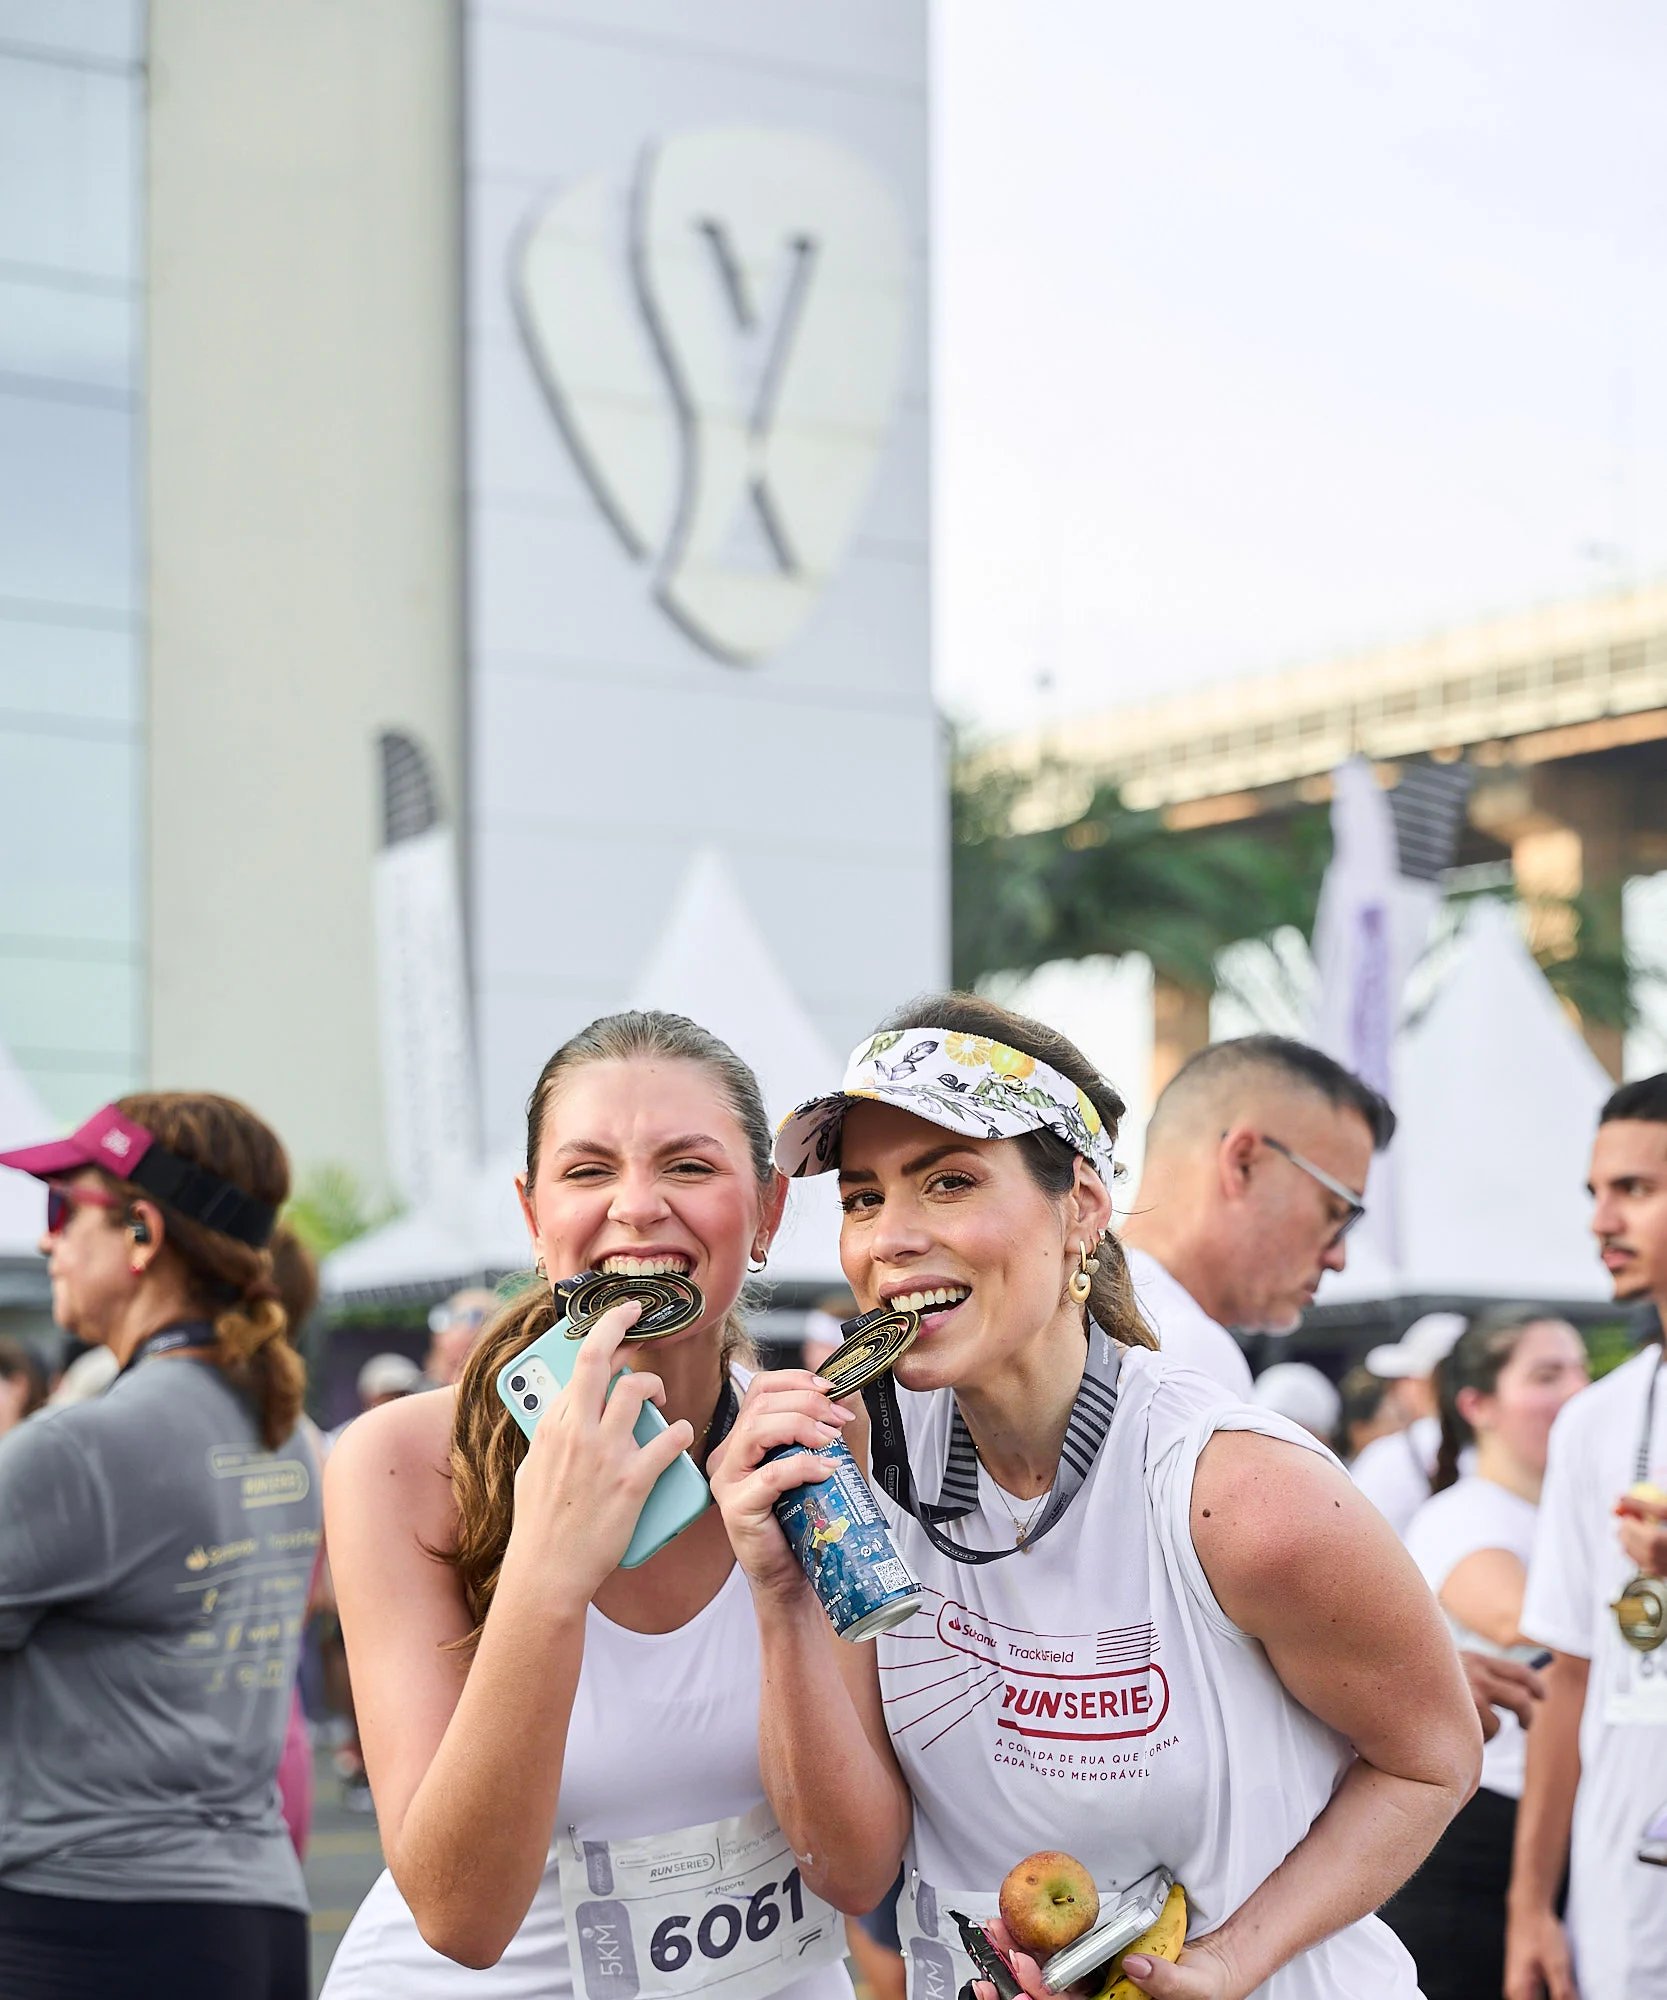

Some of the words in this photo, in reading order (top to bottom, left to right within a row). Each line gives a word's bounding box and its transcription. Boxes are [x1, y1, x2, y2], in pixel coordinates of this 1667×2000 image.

[878, 1393, 890, 1428] QUEM
[994, 1753, 1025, 1768] CADA
[1071, 1768, 1150, 1781] MEMORÁVEL
[995, 1738, 1003, 1746] A
[1059, 1754, 1074, 1763] DE
[1080, 1755, 1105, 1765] RUA
[1112, 1752, 1139, 1764] QUE
[650, 1858, 709, 1877] RUNSERIES
[650, 1866, 804, 1972] 6061
[597, 1924, 623, 1976] 5KM
[926, 1960, 944, 2000] KM
